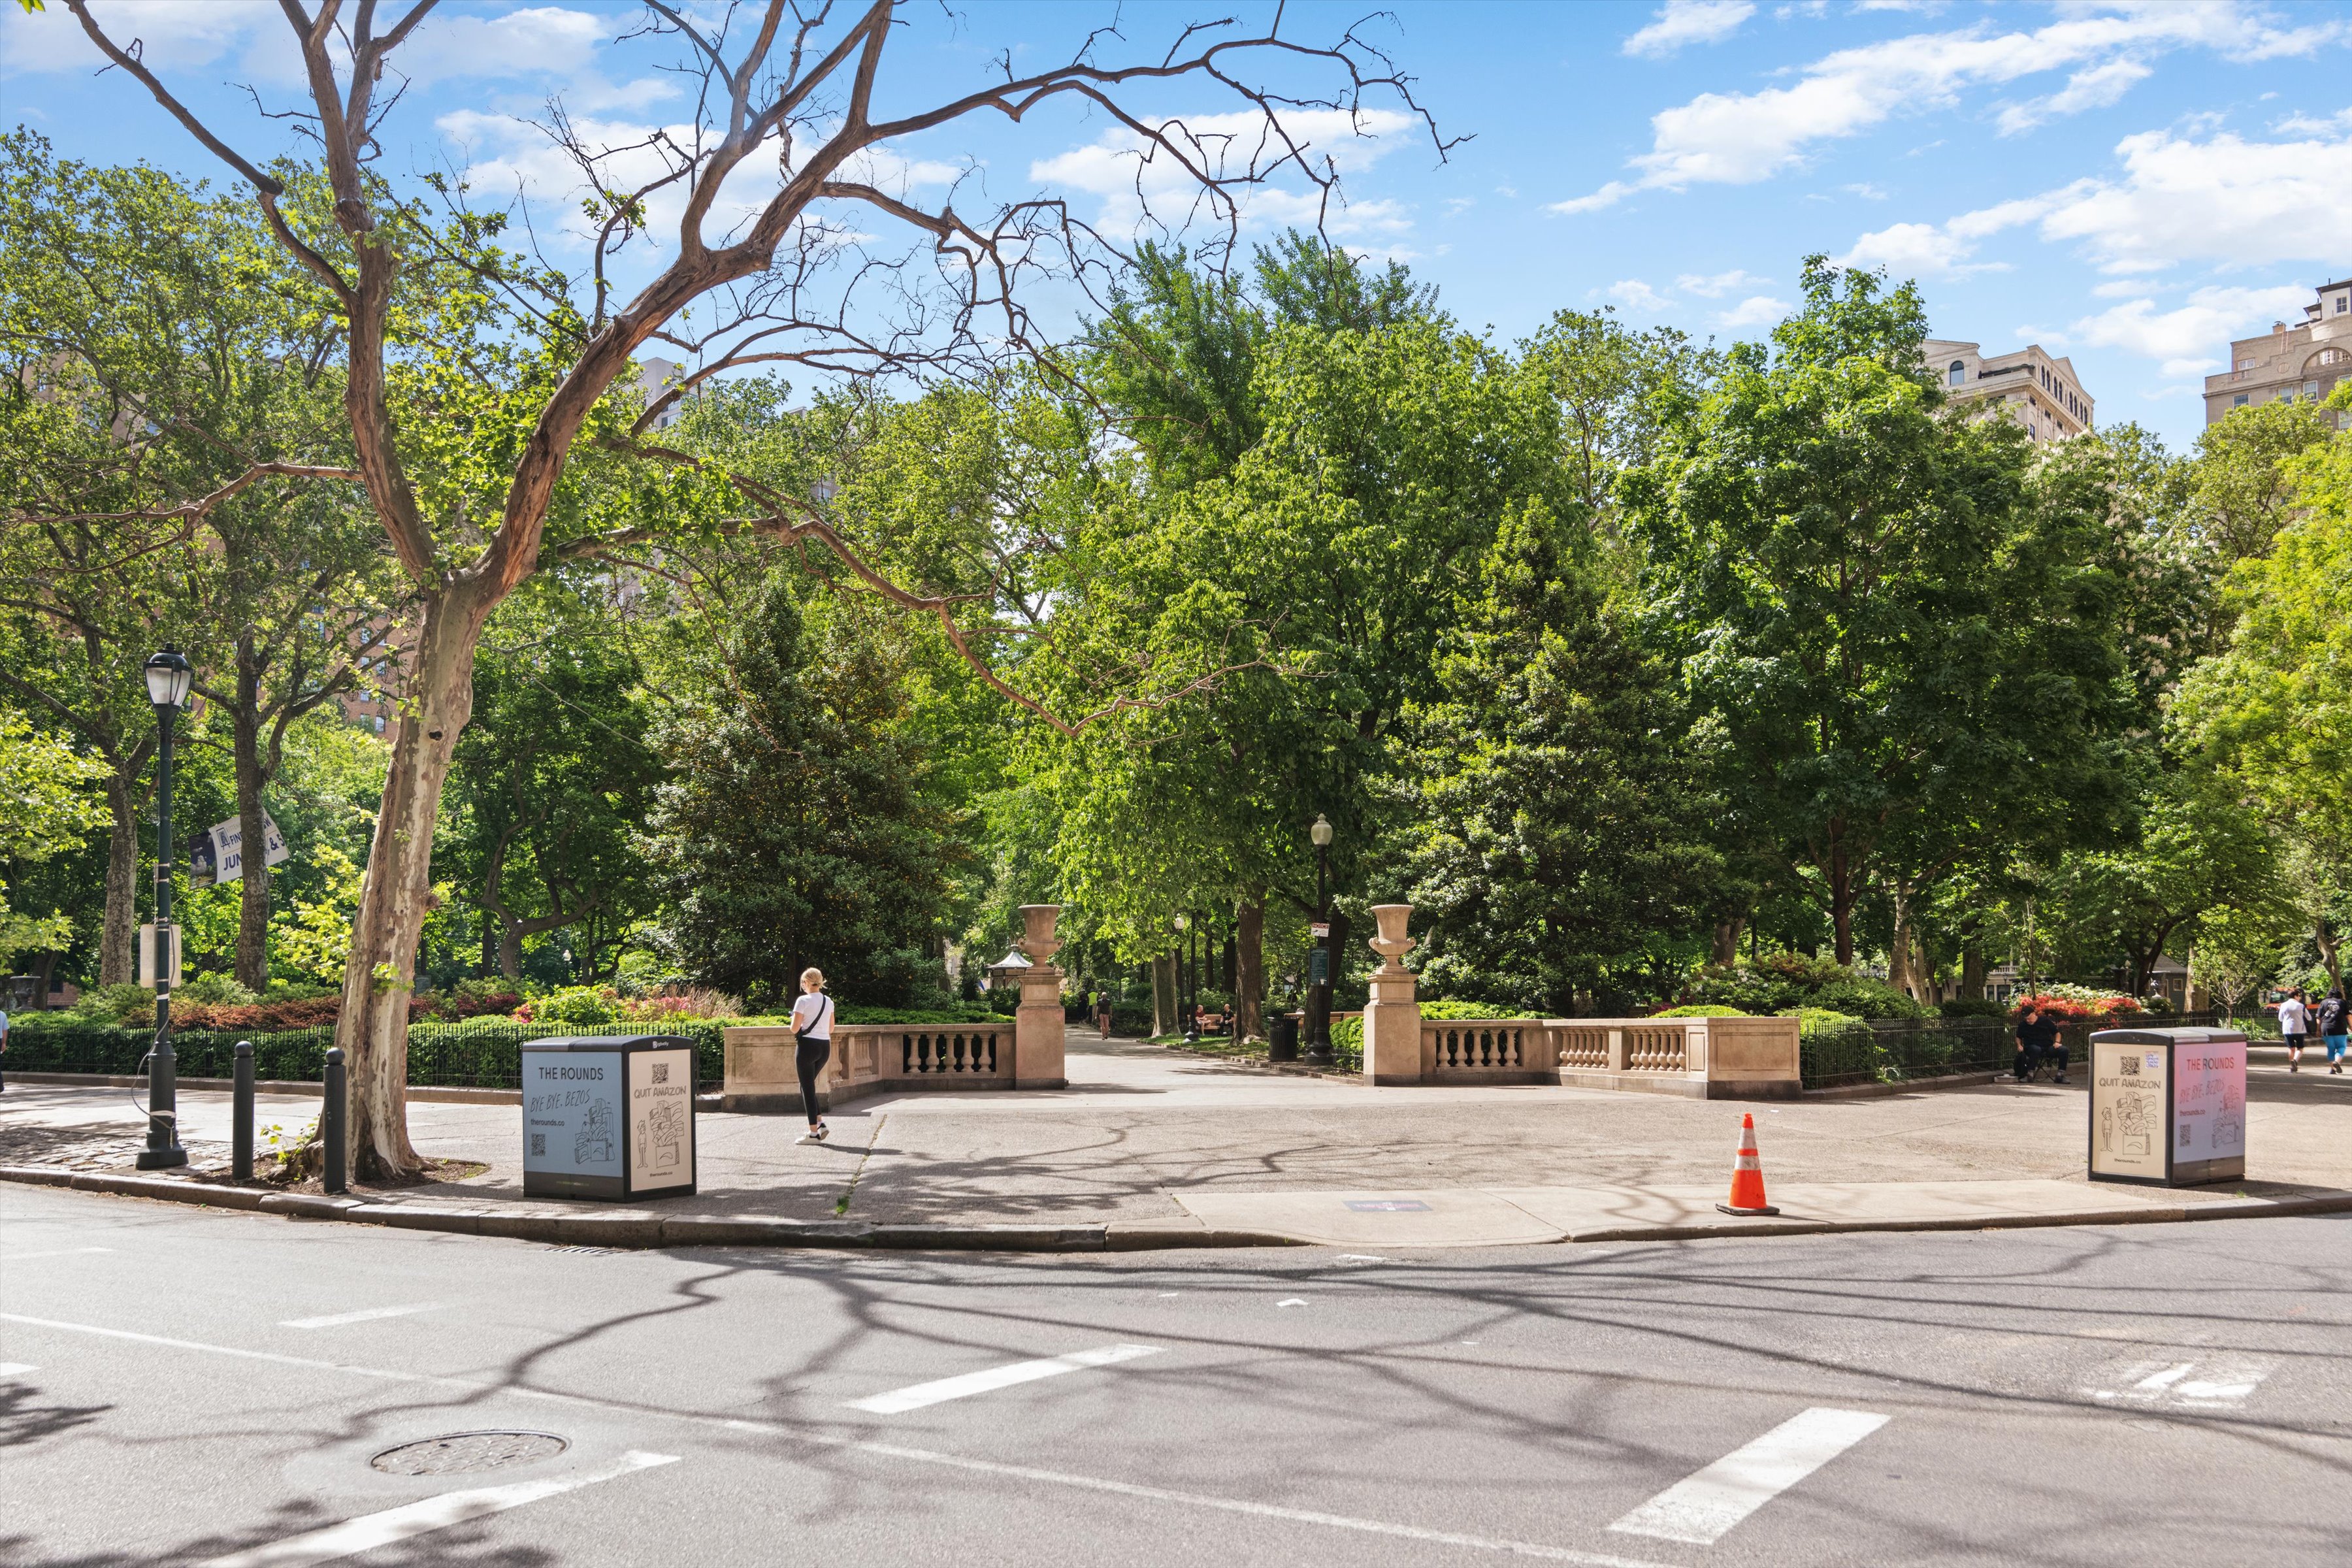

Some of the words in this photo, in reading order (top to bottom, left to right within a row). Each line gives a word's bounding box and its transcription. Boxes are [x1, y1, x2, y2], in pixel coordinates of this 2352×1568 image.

[229, 831, 242, 845] FIN
[223, 853, 242, 871] JUN
[269, 837, 280, 851] &
[2187, 1058, 2200, 1071] THE
[2202, 1056, 2234, 1070] ROUNDS
[538, 1067, 558, 1079] THE
[561, 1067, 604, 1081] ROUNDS
[2099, 1077, 2119, 1087] QUIT
[2122, 1079, 2161, 1090] AMAZON
[634, 1087, 652, 1099] QUIT
[653, 1085, 687, 1097] AMAZON
[529, 1096, 545, 1113] BYE
[564, 1088, 591, 1107] BEZOS
